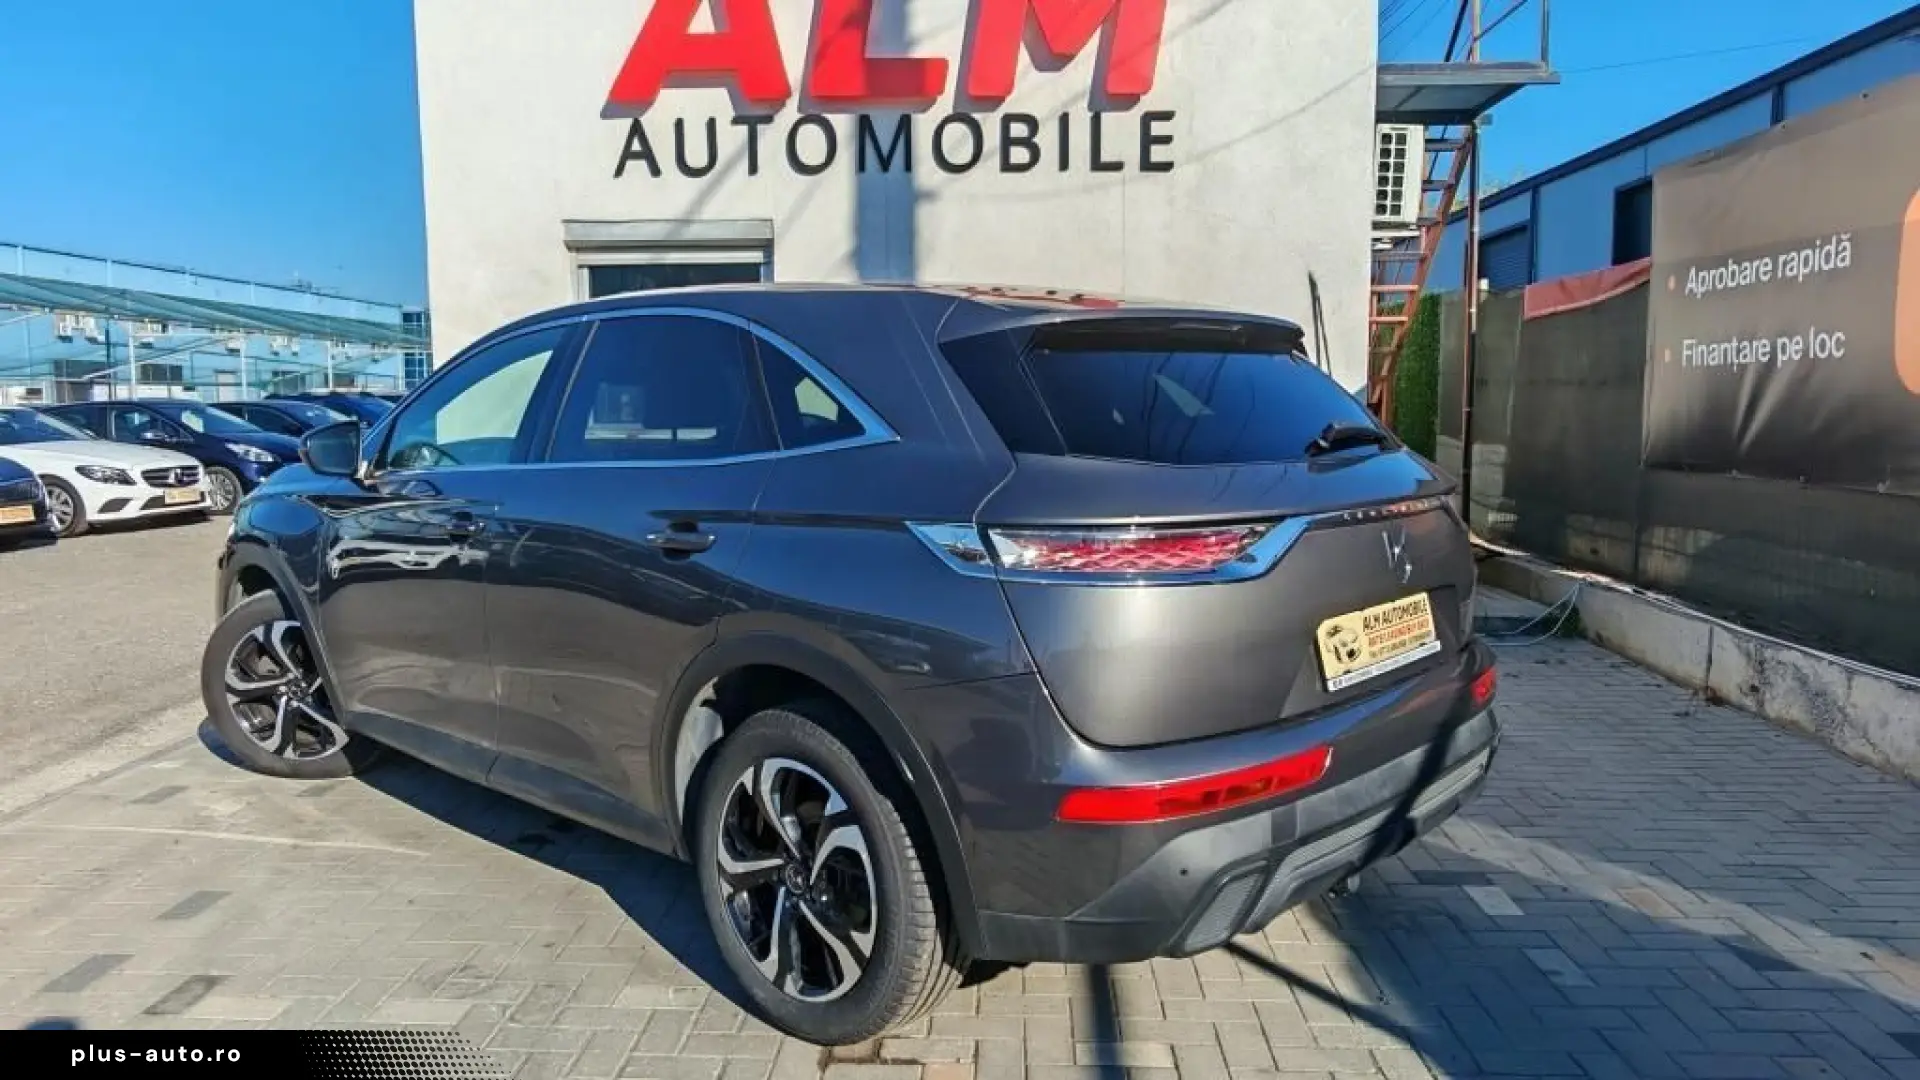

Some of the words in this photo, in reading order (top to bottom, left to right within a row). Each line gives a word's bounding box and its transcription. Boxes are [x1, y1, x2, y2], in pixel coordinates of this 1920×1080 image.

[605, 0, 1166, 105] ALM
[613, 110, 1176, 178] AUTOMOBILE
[1684, 256, 1773, 298] Aprobare
[1777, 232, 1852, 283] rapidă
[1681, 336, 1771, 372] Finanțare
[1776, 335, 1803, 368] pe
[1808, 325, 1846, 359] loc
[1381, 597, 1429, 626] AUTOMOBILE
